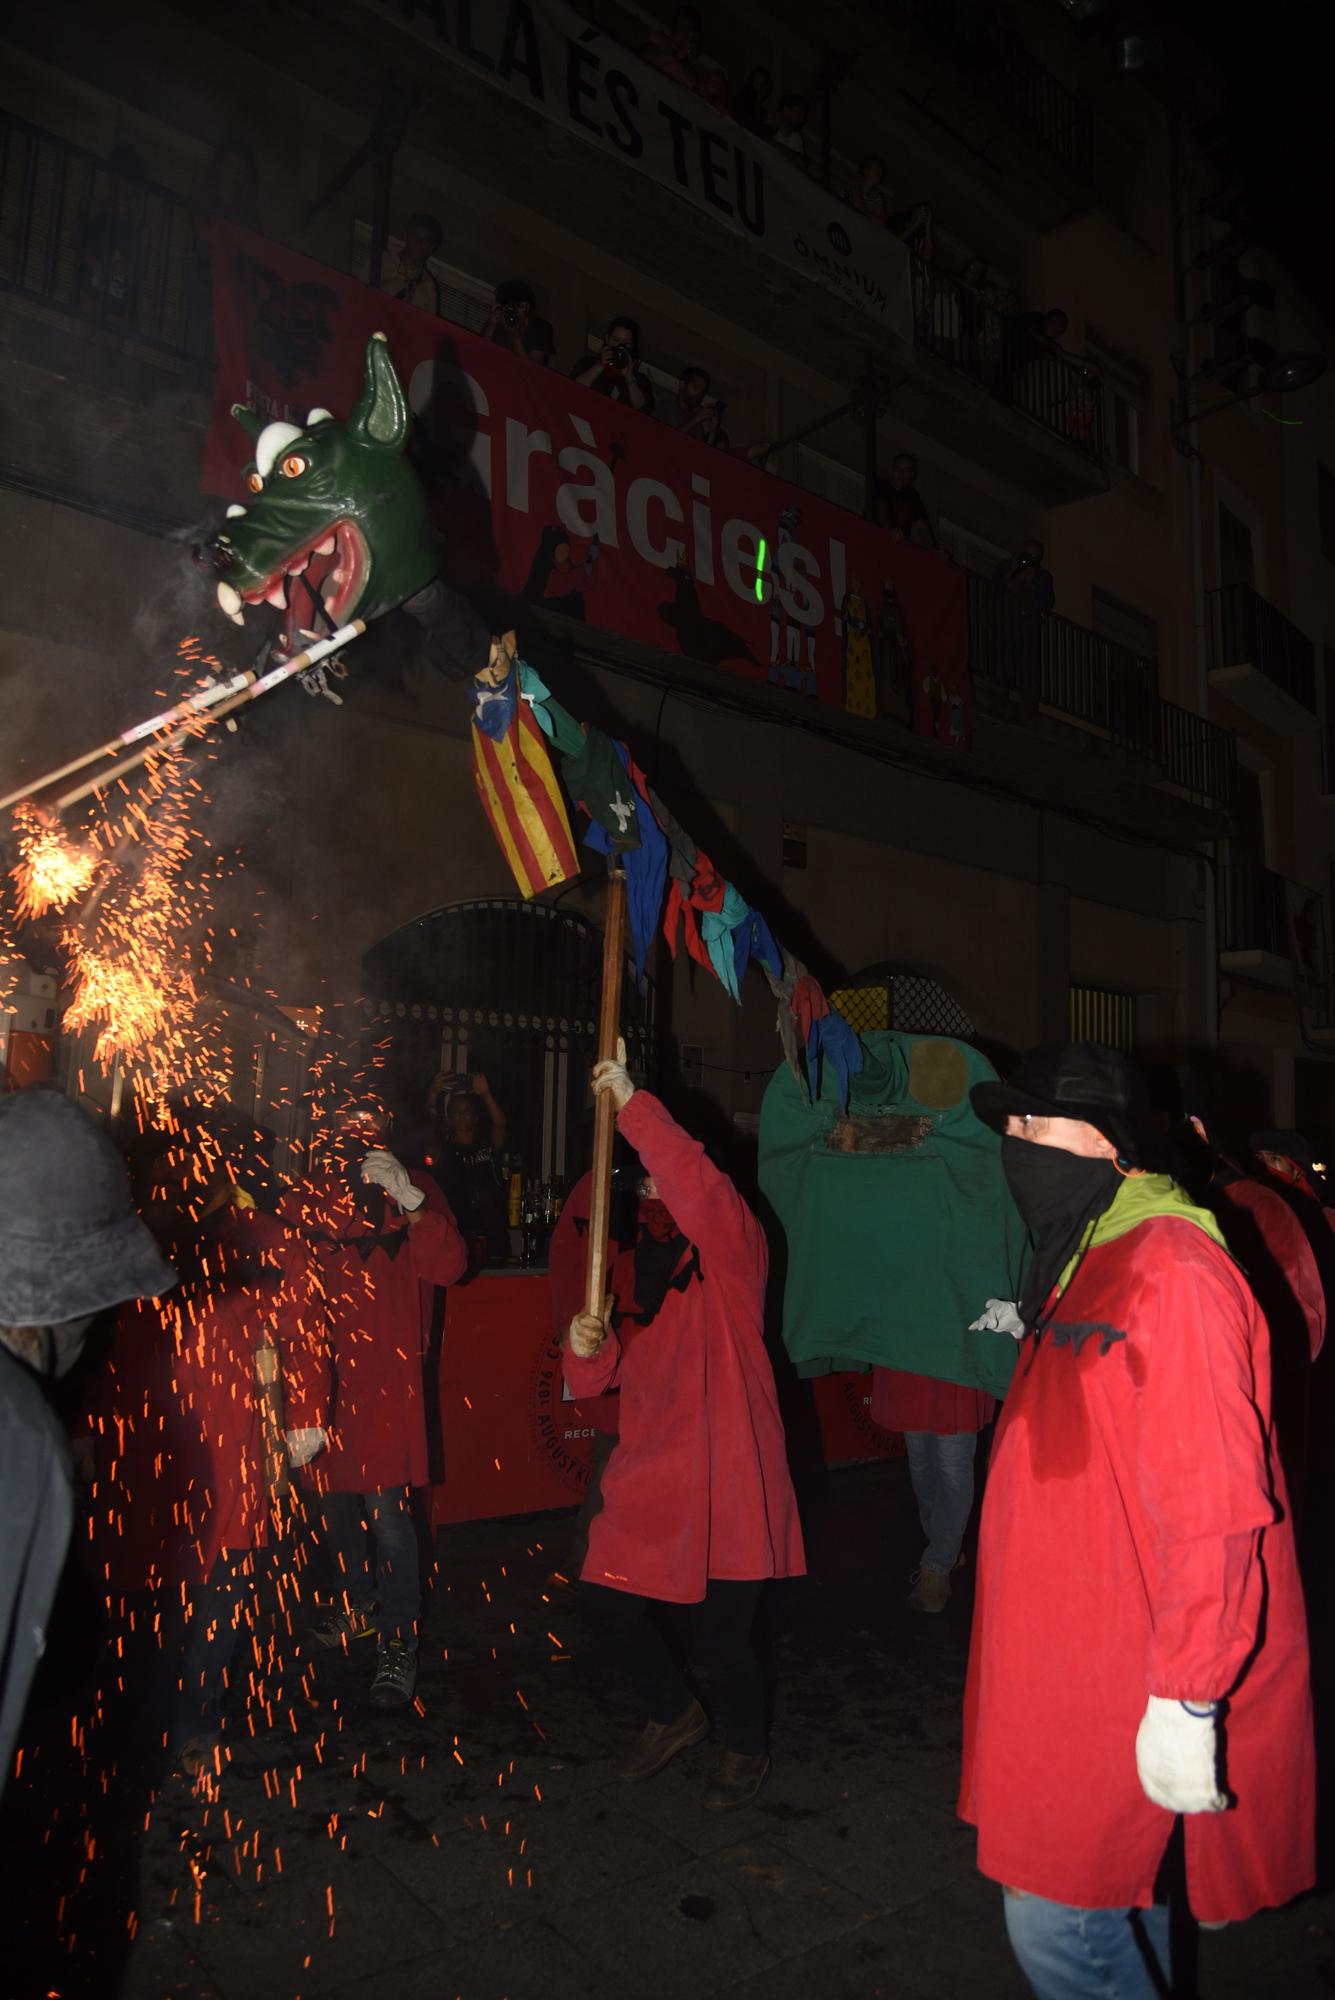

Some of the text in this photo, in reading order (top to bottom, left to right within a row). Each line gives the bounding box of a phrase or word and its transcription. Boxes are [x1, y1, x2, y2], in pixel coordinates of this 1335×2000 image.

[566, 28, 643, 159] ÉS
[657, 101, 766, 237] TEU
[537, 1370, 553, 1407] 1876
[537, 1414, 577, 1475] AUGUST
